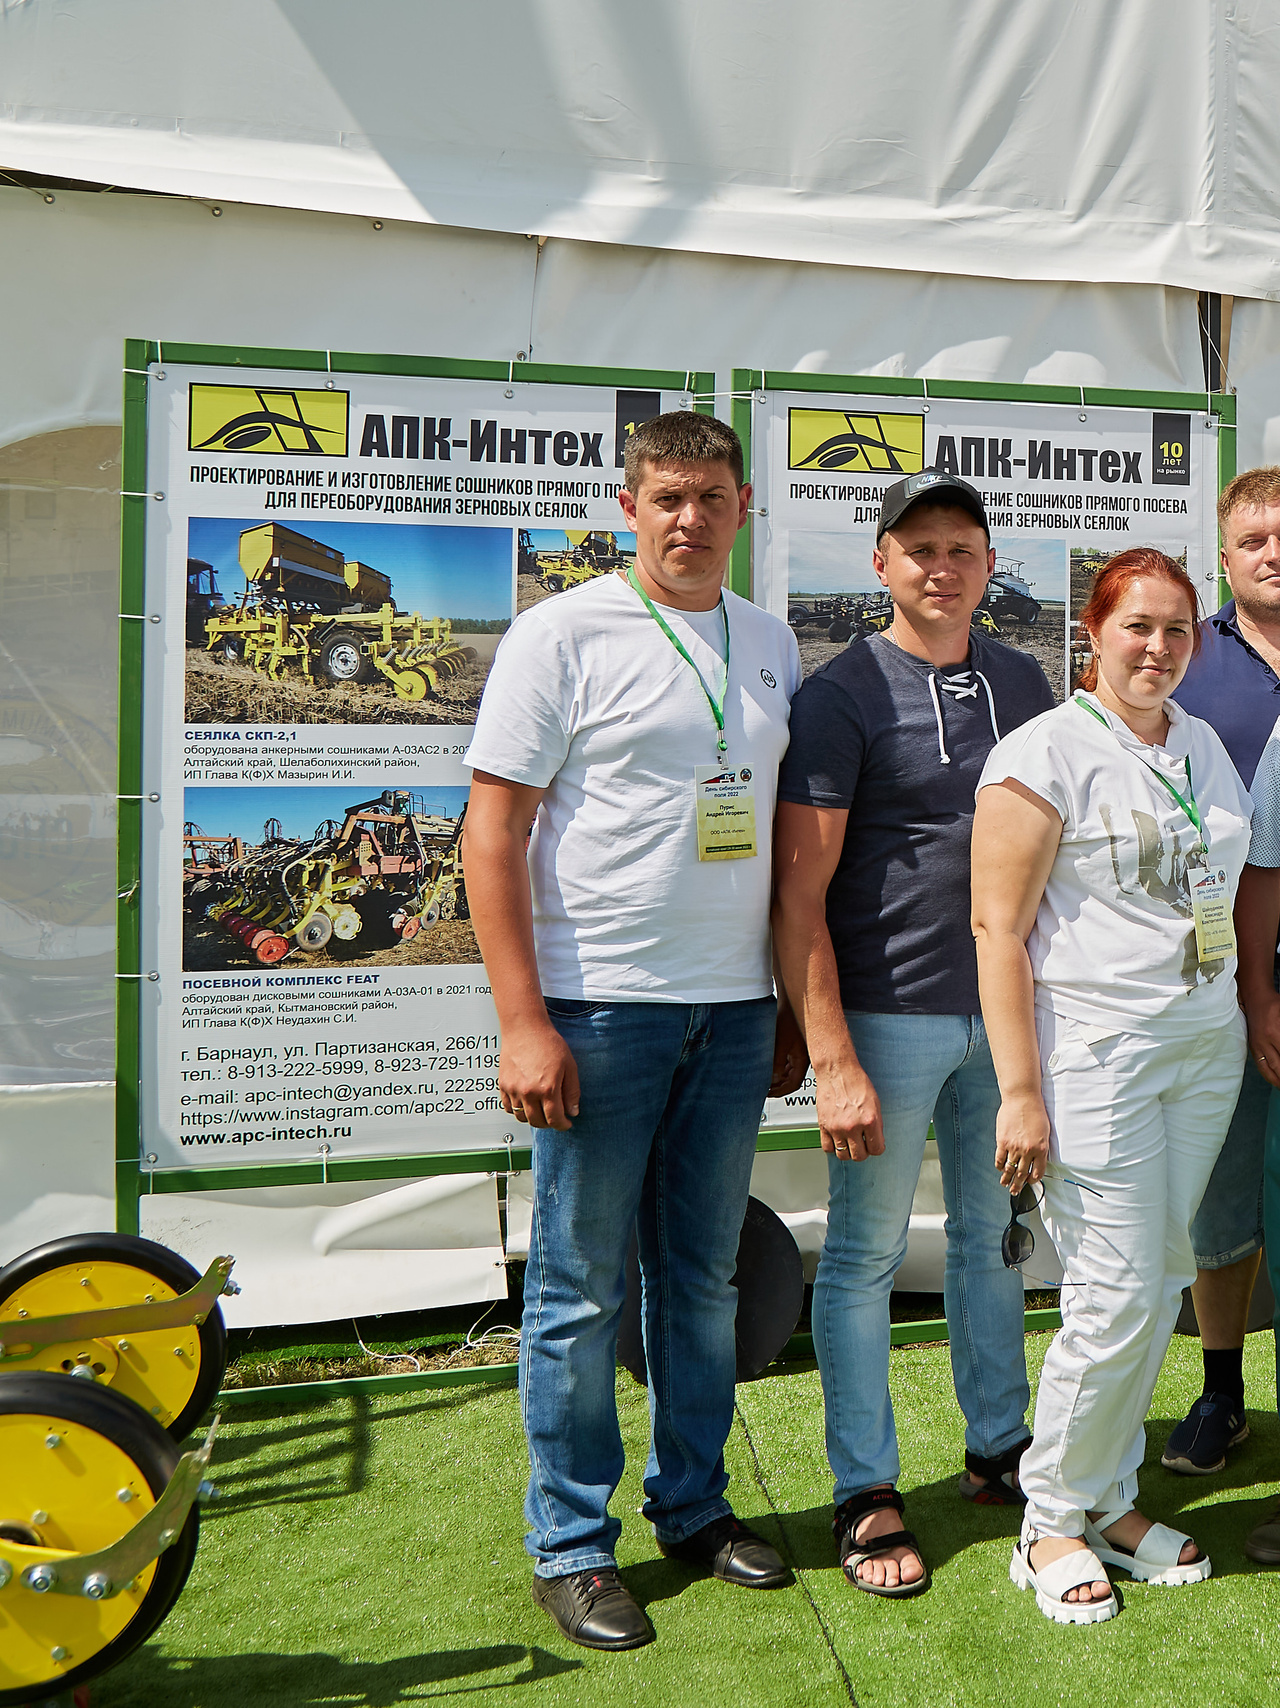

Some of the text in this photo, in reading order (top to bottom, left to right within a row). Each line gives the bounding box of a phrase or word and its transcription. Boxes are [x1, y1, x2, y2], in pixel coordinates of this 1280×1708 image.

[358, 413, 604, 468] АПК-Интех
[1159, 441, 1184, 459] 10
[935, 435, 1143, 485] АПК-Интех
[1162, 458, 1182, 466] лет
[189, 465, 628, 499] ПРОЕКТИРОВАНИЕ И ИЗГОТОВЛЕНИЕ СОШНИКОВ ПРЯМОГО ПО
[264, 490, 588, 519] ДЛЯ ПЕРЕОБОРУДОВАНИЯ ЗЕРНОВЫХ СЕЯЛОК
[1016, 492, 1083, 510] СОШНИКОВ
[1085, 495, 1141, 513] ПРЯМОГО
[1143, 498, 1188, 515] ПОСЕВА
[853, 506, 881, 524] ДЛЯ
[1016, 512, 1082, 530] ЗЕРНОВЫХ
[1084, 515, 1130, 532] СЕЯЛОК
[184, 731, 297, 742] СЕЯЛКА СКП-2,1
[183, 744, 258, 756] оборудована
[261, 746, 324, 756] анкерными
[327, 745, 390, 755] сошниками
[392, 745, 440, 755] А-03АС2
[442, 746, 449, 755] в
[183, 757, 420, 769] Алтайский край, Шелаболихинский район,
[183, 769, 356, 781] ИП Глава К(Ф)Х Мазырин И.И.
[182, 974, 380, 990] ПОСЕВНОЙ КОМПЛЕКС FEAT
[182, 993, 250, 1005] оборудован
[252, 992, 316, 1003] дисковыми
[318, 989, 381, 1000] сошниками
[383, 986, 433, 997] А-03А-01
[436, 987, 443, 996] в
[446, 985, 471, 995] 2021
[182, 1000, 398, 1017] Алтайский край, Кытмановский район,
[182, 1013, 357, 1029] ИП Глава К(Ф)Х Неудахин С.И.
[181, 1034, 499, 1063] г. Барнаул, ул. Партизанская, 266/11
[180, 1069, 222, 1082] тел.:
[227, 1060, 369, 1080] 8-913-222-5999,
[180, 1089, 239, 1106] e-mail:
[244, 1081, 439, 1106] apc-intech@yandex.ru,
[180, 1124, 352, 1146] www.apc-intech.ru
